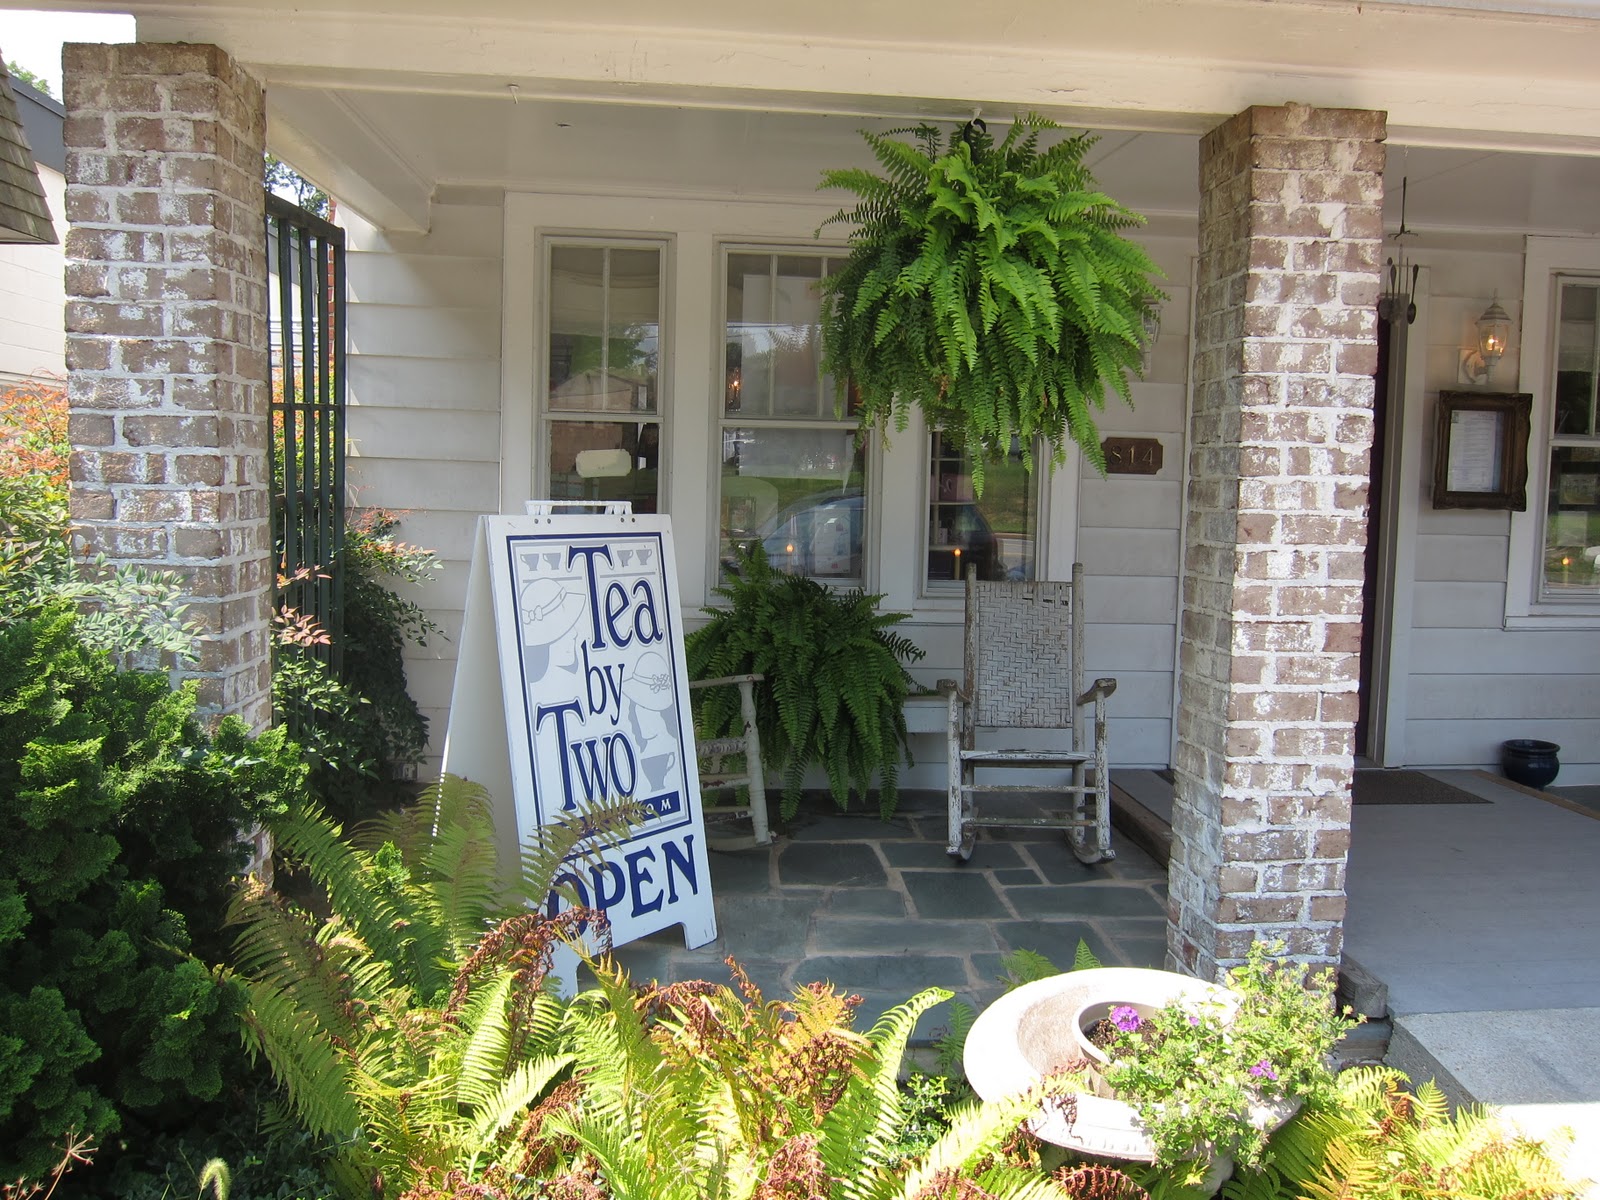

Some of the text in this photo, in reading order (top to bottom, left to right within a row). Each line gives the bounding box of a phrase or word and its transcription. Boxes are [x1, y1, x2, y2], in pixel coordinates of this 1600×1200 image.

[568, 545, 663, 648] Tea
[581, 640, 625, 725] by
[536, 699, 636, 811] Two
[548, 834, 698, 941] OPEN
